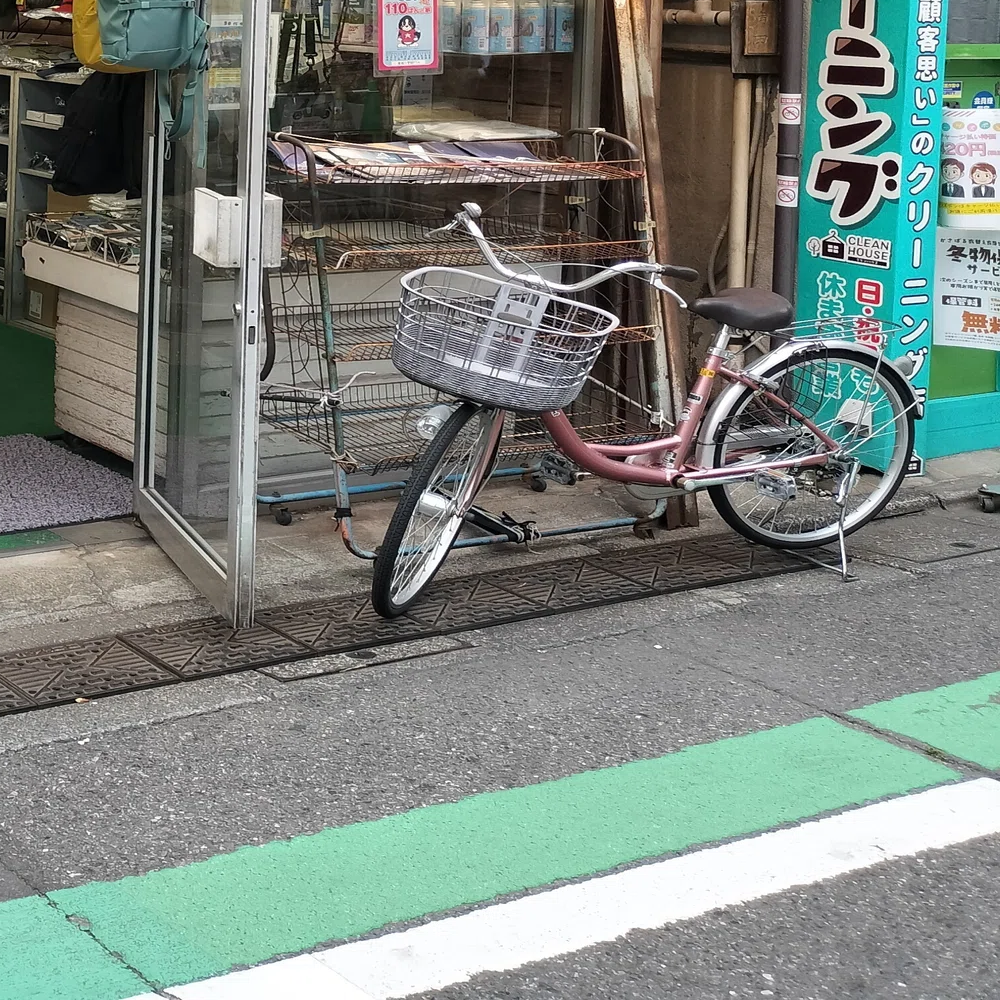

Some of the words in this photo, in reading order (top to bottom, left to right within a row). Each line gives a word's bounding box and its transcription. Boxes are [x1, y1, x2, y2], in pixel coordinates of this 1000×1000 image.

[941, 142, 986, 157] 20円
[848, 236, 890, 251] CLEAN
[848, 247, 889, 260] HOUSE
